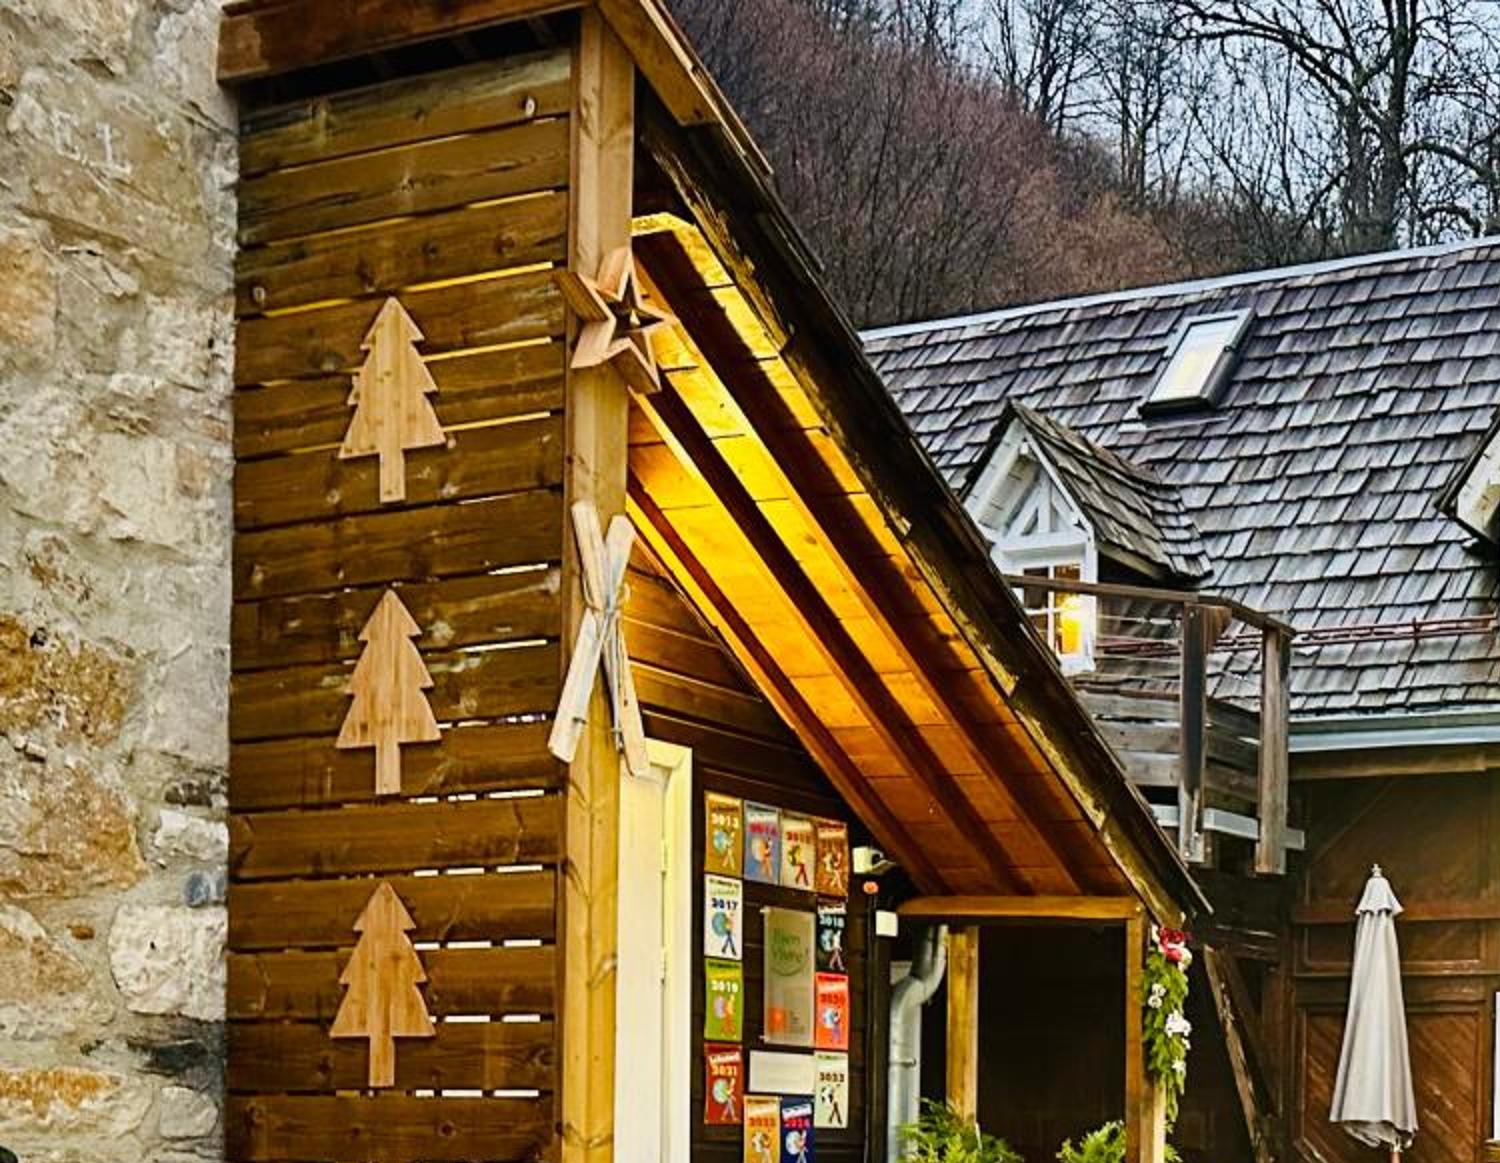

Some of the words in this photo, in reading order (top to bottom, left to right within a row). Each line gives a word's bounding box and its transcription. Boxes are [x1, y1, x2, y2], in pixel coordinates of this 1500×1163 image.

[711, 812, 740, 830] 2013
[711, 897, 738, 911] 2017
[819, 914, 845, 929] 2018
[711, 979, 738, 993] 2019
[711, 1064, 737, 1077] 2021
